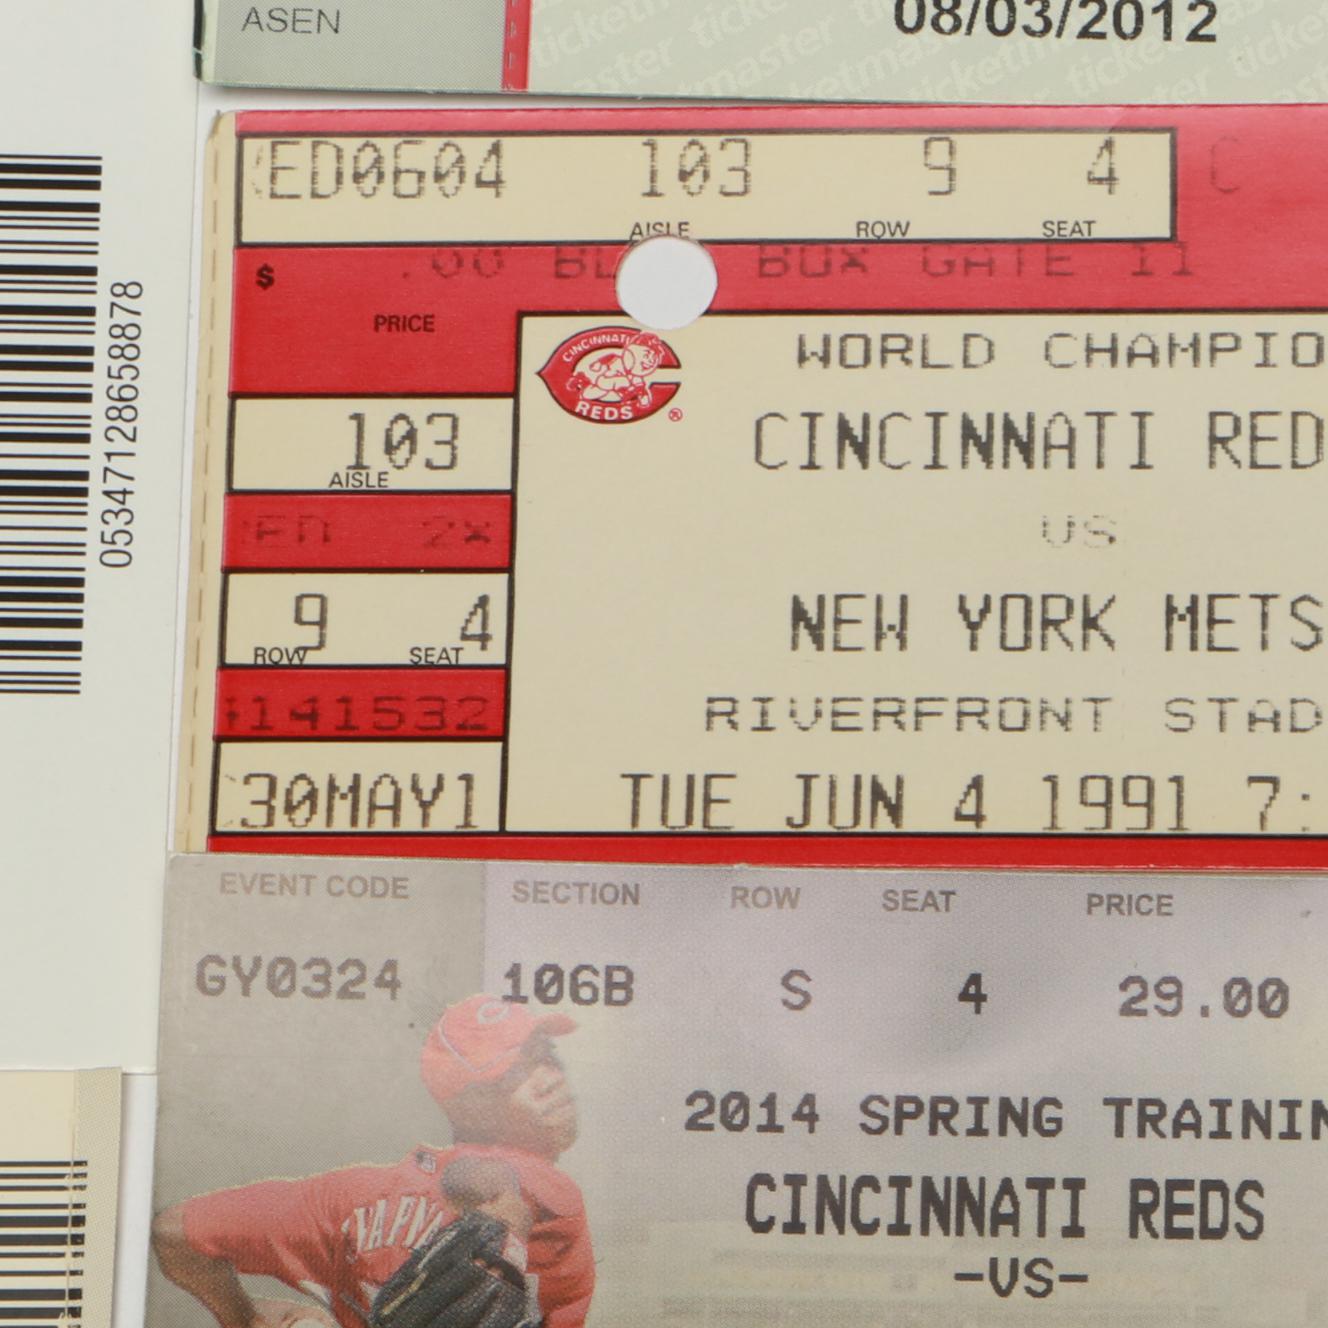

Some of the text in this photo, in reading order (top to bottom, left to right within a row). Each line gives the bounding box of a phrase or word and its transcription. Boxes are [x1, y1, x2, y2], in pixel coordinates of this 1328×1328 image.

[242, 8, 340, 34] ASEN
[894, 0, 1217, 42] 08/03/2012
[641, 139, 752, 197] 103
[924, 137, 956, 195] 9
[1087, 136, 1117, 195] 4
[629, 221, 1096, 239] AISLE ROW SEAT
[256, 264, 274, 289] $
[374, 315, 435, 332] PRICE
[799, 333, 994, 368] WORLD
[99, 281, 143, 568] 05347128658878
[576, 400, 633, 421] REDS
[347, 413, 458, 471] 103
[754, 412, 1155, 470] CINCINNATI
[329, 472, 389, 488] AISLE
[294, 594, 492, 651] 9 4
[792, 594, 1322, 651] NEW YORK METS
[254, 648, 464, 665] ROW SEAT
[706, 697, 1113, 732] RIVERFRONT
[620, 773, 737, 828] TUE
[786, 773, 904, 829] JUN
[955, 773, 985, 829] 4
[1042, 775, 1188, 830] 1991
[220, 872, 410, 899] EVENT CODE
[512, 880, 640, 906] SECTION
[731, 885, 801, 910] ROW
[882, 890, 956, 913] SEAT
[1086, 893, 1174, 917] PRICE
[196, 955, 402, 1001] GY0324
[502, 964, 635, 1006] 106B
[780, 970, 813, 1011] S
[958, 972, 988, 1014] 4
[1119, 976, 1289, 1018] 29.00
[685, 1091, 820, 1134] 2014
[859, 1094, 1064, 1139] SPRING
[744, 1173, 1265, 1240] CINCINNATI REDS
[954, 1256, 1088, 1299] -VS-
